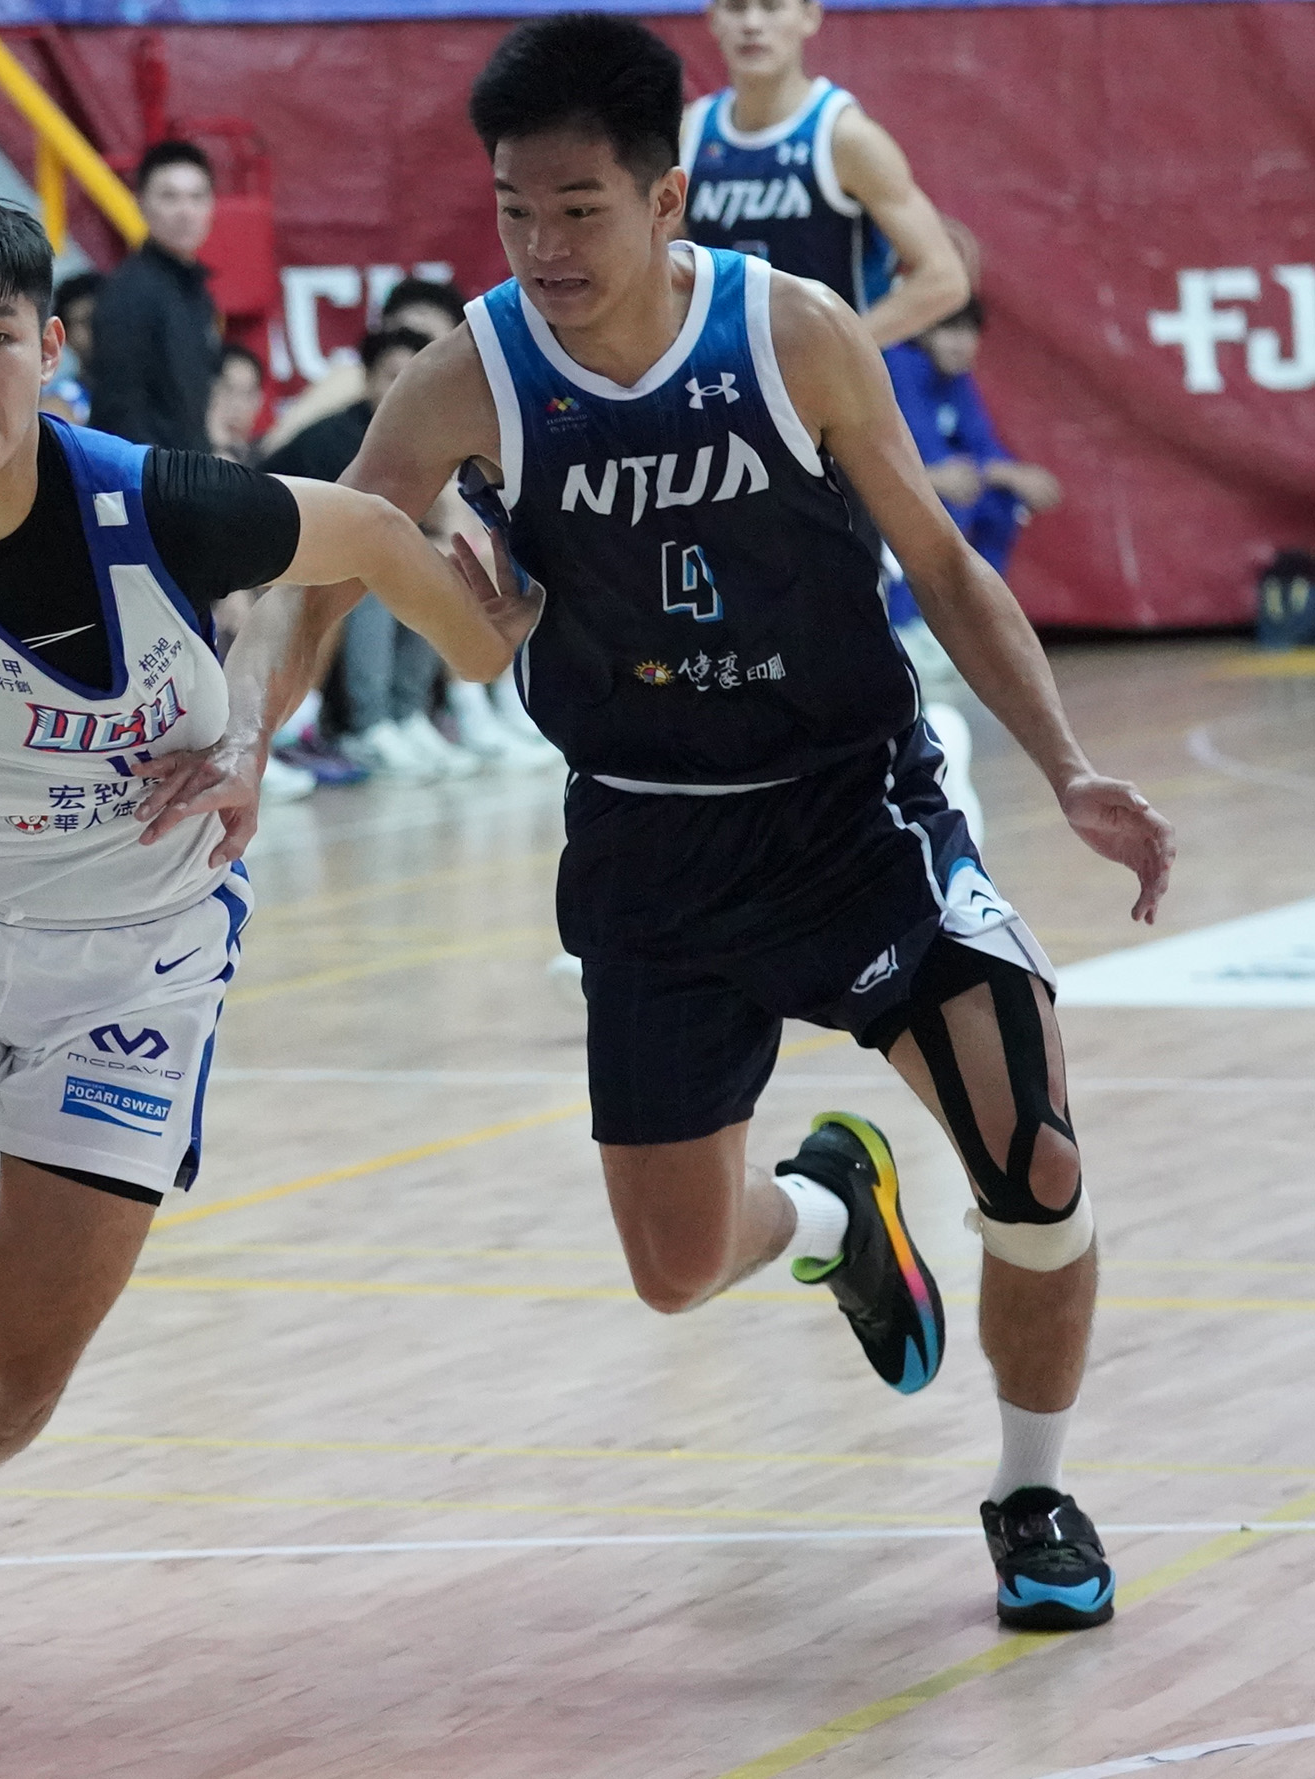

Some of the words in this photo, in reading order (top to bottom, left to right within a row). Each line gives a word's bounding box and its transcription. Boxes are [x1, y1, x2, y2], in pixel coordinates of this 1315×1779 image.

[691, 173, 812, 231] NTUA
[561, 430, 770, 527] NTUA
[661, 540, 723, 622] 4
[143, 640, 183, 690] 新世界
[24, 678, 186, 753] UCH
[67, 1084, 119, 1105] POCARI
[122, 1097, 169, 1118] SWEAT
